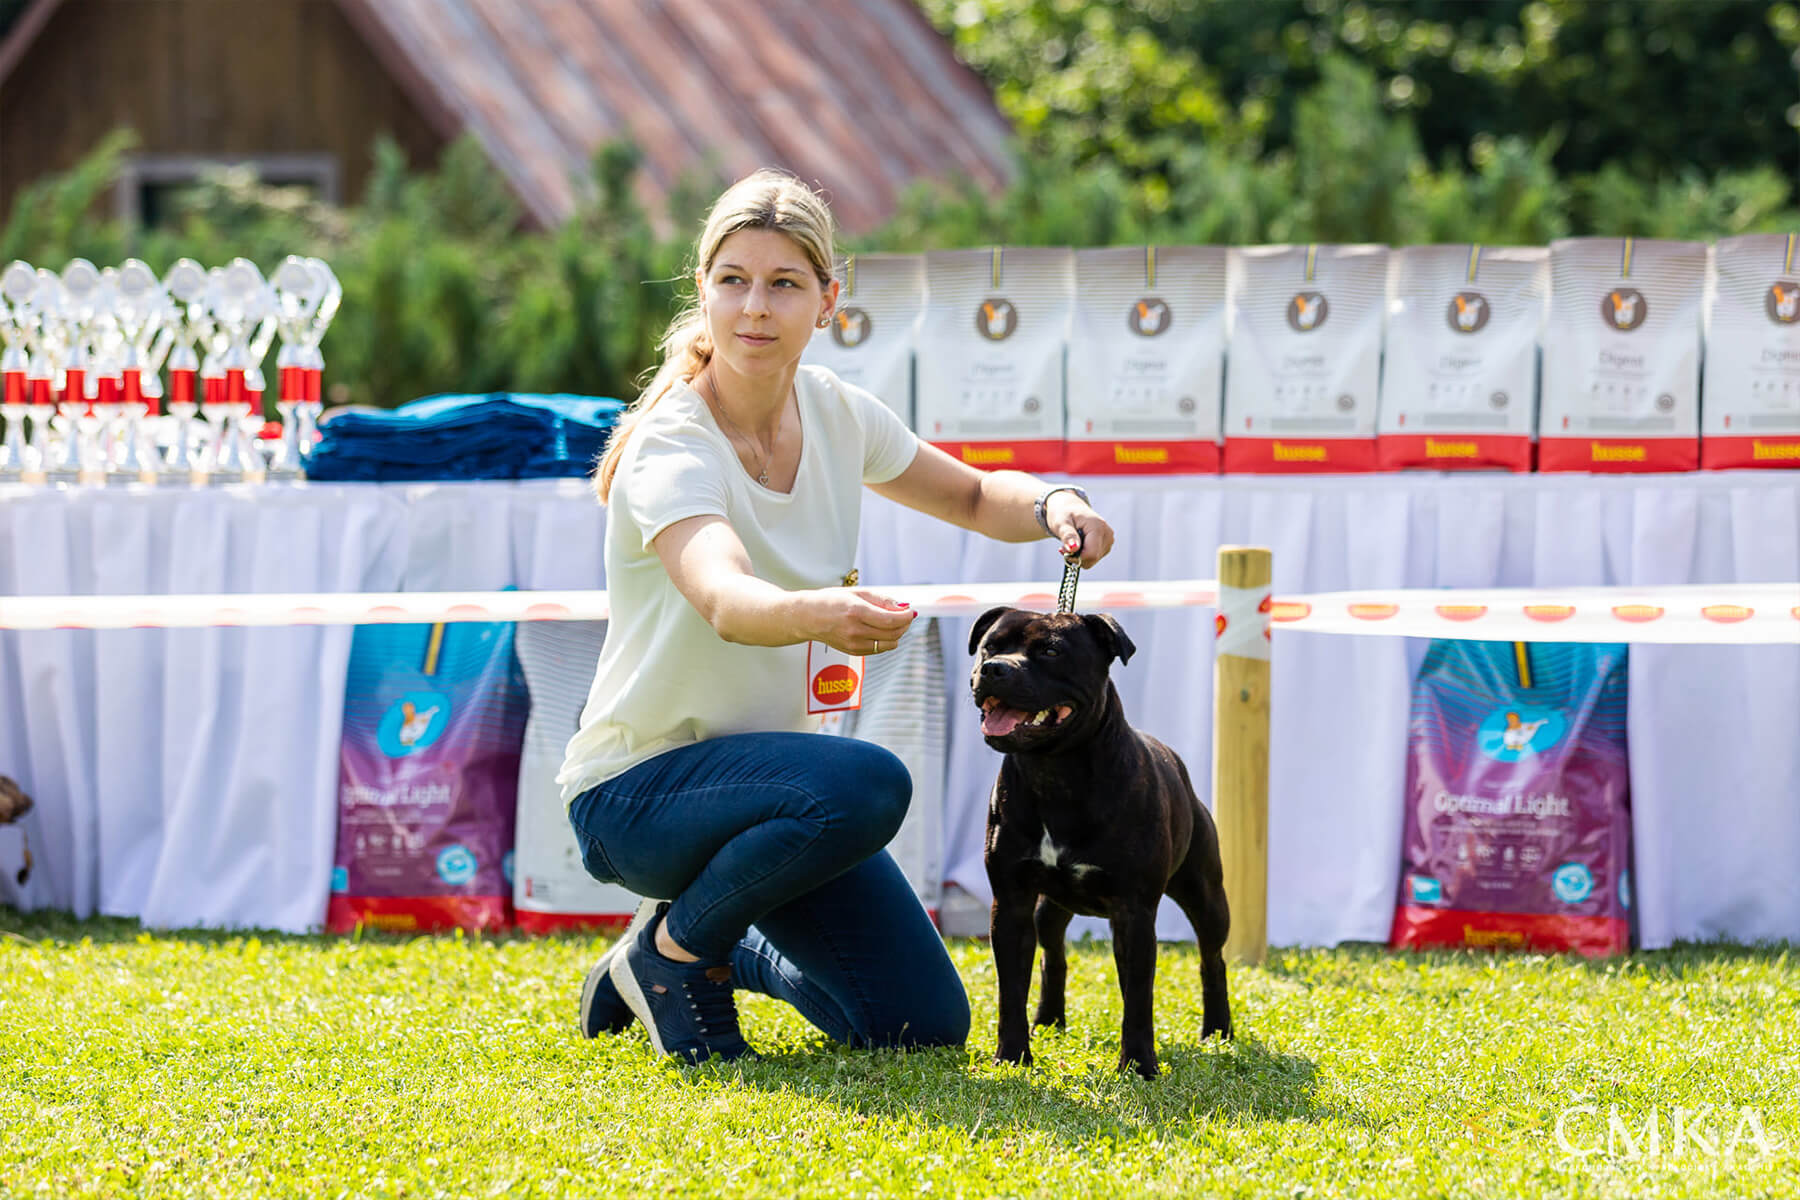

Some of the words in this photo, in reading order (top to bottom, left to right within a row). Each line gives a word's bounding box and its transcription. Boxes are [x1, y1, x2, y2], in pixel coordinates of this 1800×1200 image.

[962, 445, 1014, 464] husse
[1114, 444, 1168, 464] husse
[1273, 441, 1326, 461] husse
[1426, 438, 1478, 458] husse
[1591, 442, 1646, 461] husse
[817, 676, 853, 695] husse
[1435, 792, 1513, 816] Optimal
[1515, 793, 1570, 819] Light
